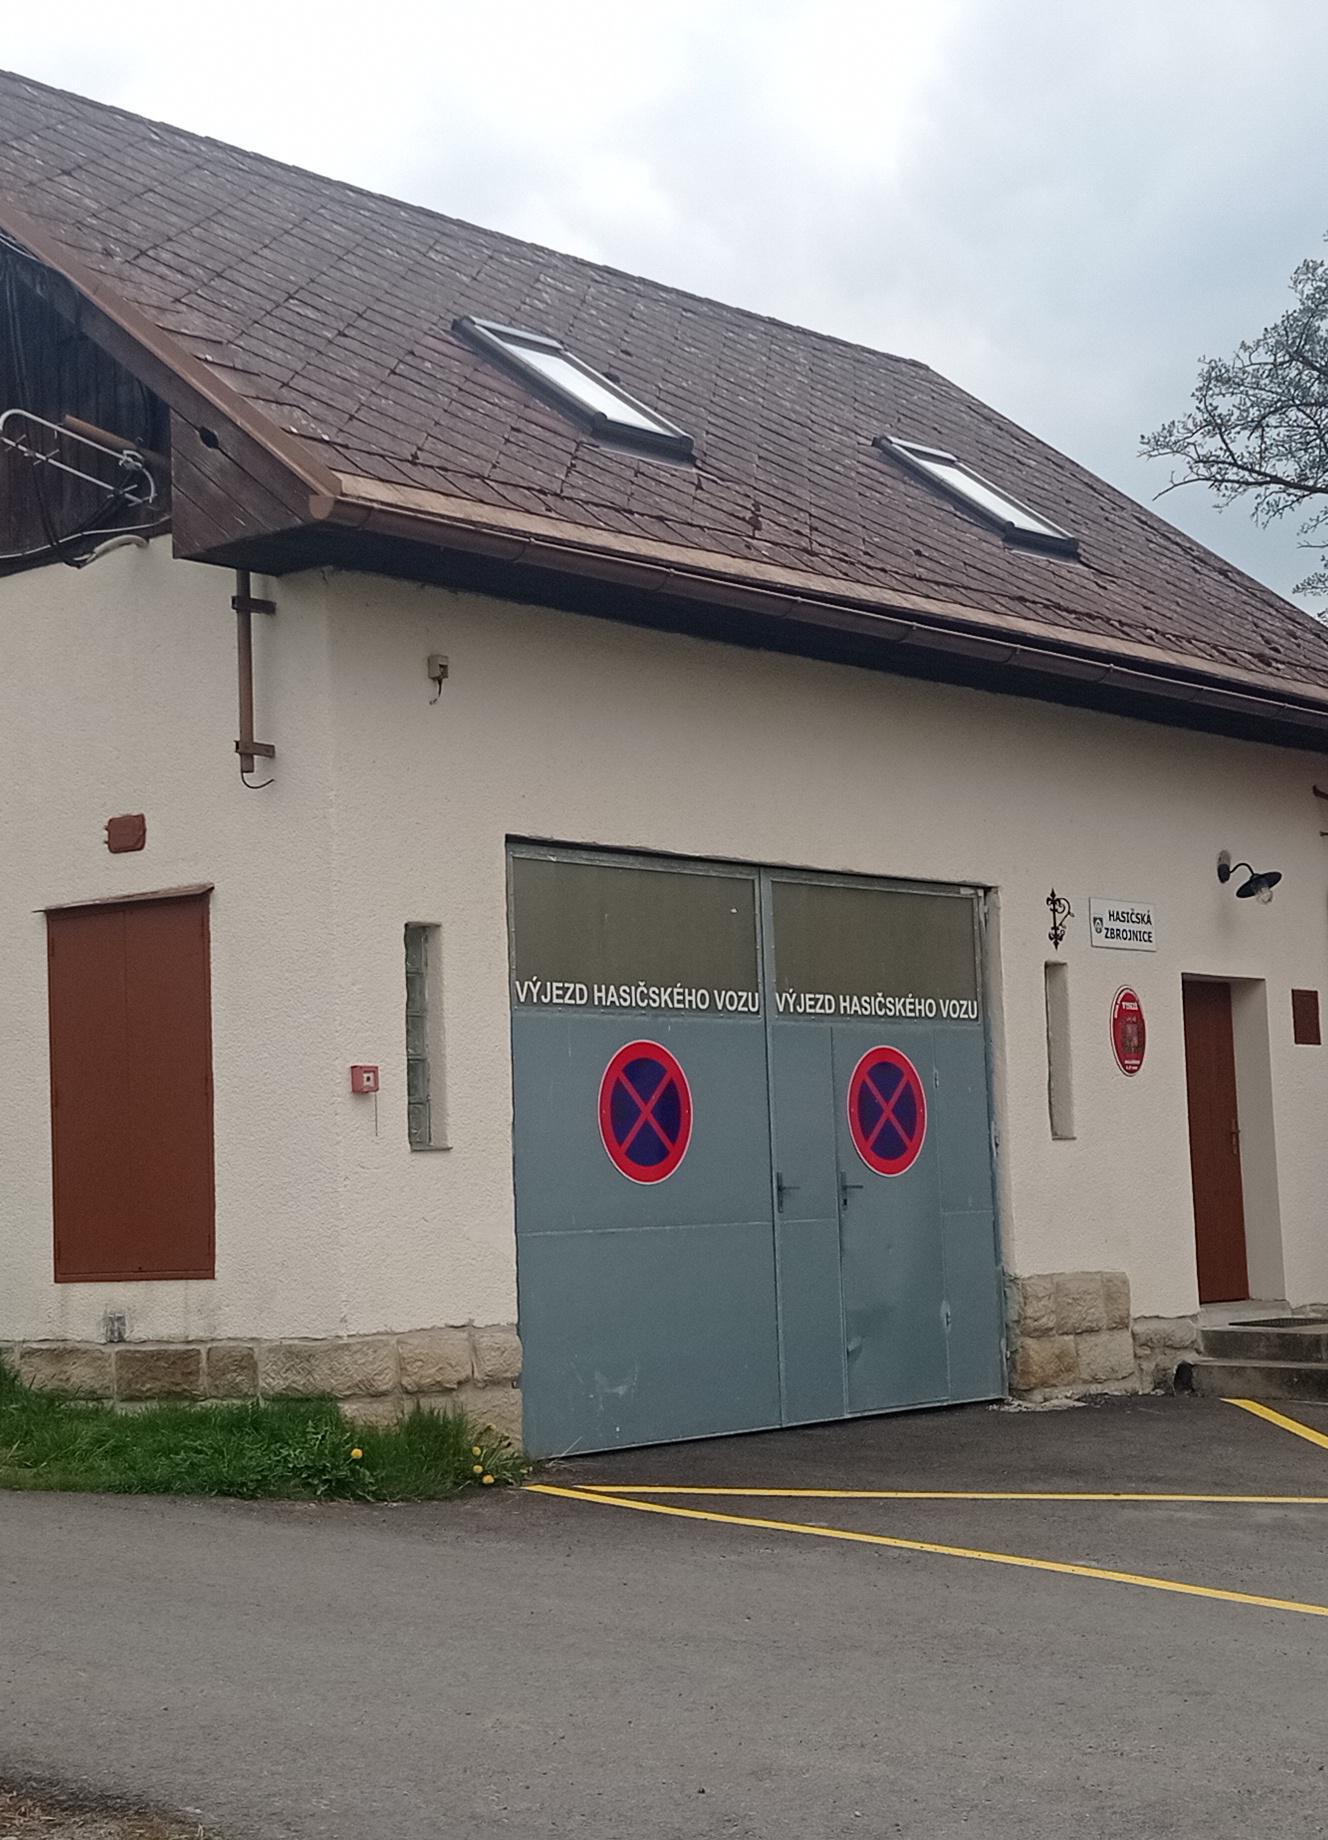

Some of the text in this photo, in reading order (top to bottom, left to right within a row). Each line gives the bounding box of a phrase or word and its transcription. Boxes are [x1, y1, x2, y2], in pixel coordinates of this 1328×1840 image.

[1108, 908, 1152, 926] HASIČSKÁ
[1104, 927, 1153, 943] ZBROJNICE
[515, 976, 760, 1013] VÝJEZD HASIČSKÉHO VOZU
[775, 987, 979, 1019] VÝJEZD HASIČSKÉHO VOZU
